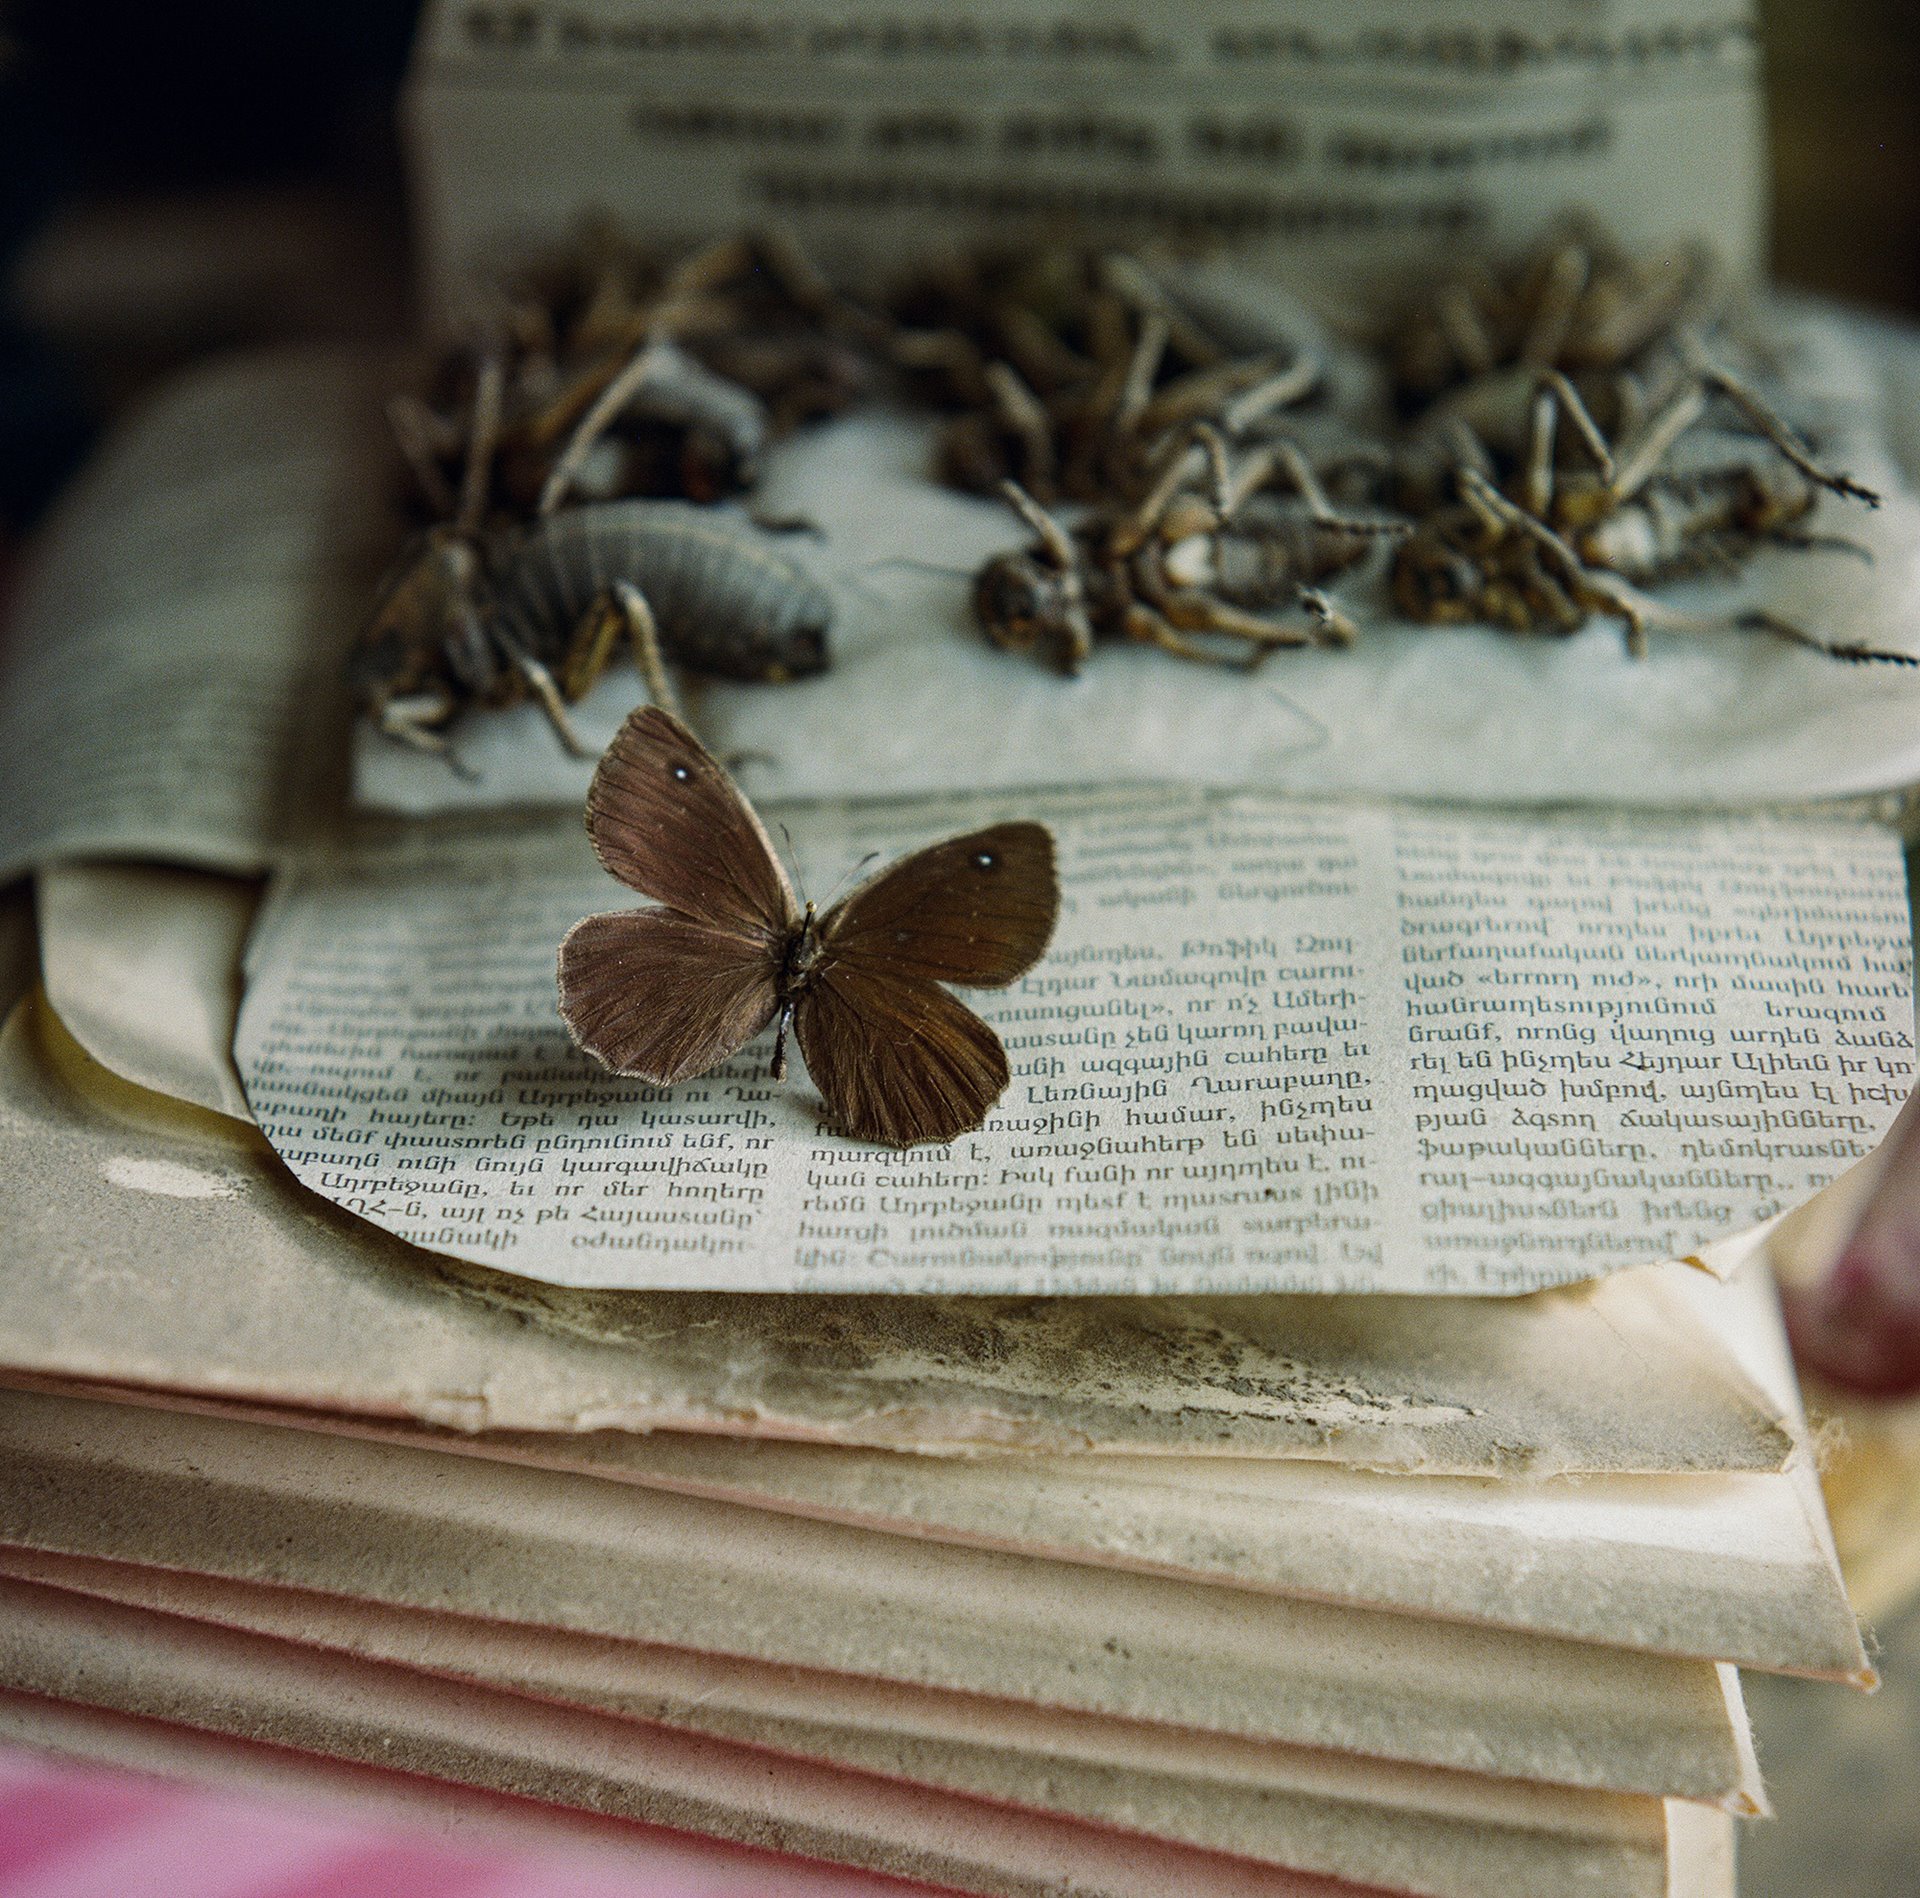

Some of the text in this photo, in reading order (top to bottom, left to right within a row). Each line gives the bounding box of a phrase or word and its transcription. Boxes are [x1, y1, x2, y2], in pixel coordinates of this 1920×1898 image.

[1404, 970, 1464, 994] ված
[1674, 972, 1717, 994] որի
[1731, 974, 1825, 998] մասին
[1837, 978, 1910, 999] հարե
[1188, 999, 1215, 1014] որ
[1273, 988, 1367, 1010] Ամերի-
[1406, 996, 1887, 1025] հանրապետությունում երազում
[1003, 1015, 1368, 1051] աստանը չեն կարող բավա-
[1408, 1022, 1501, 1043] նրանք,
[1517, 1022, 1596, 1045] որոնց
[1730, 1026, 1820, 1048] արդեն
[1835, 1028, 1914, 1050] ձանձ
[1081, 1049, 1208, 1075] ազգային
[1225, 1044, 1328, 1065] շահերը
[1411, 1053, 1450, 1074] րել
[1457, 1050, 1492, 1069] են
[1502, 1050, 1611, 1073] ինչպես
[1620, 1050, 1722, 1074] Հեյդար
[1838, 1053, 1867, 1077] իր
[686, 1090, 709, 1103] ու
[1027, 1070, 1372, 1105] Լեռնային Ղարաբաղը,
[1413, 1078, 1909, 1106] պացված խմբով, այնպես էլ իշխ
[500, 1112, 554, 1130] Եթե
[577, 1115, 619, 1130] դա
[642, 1110, 776, 1130] կատարվի,
[1125, 1106, 1236, 1126] համար,
[1260, 1095, 1373, 1121] ինչպես
[1416, 1107, 1876, 1134] թյան ձգտող ճակատայինները,
[313, 1126, 378, 1146] մենք
[384, 1131, 526, 1151] փաստորեն
[537, 1134, 672, 1154] ընդունում
[683, 1133, 735, 1152] ենք,
[745, 1137, 775, 1150] որ
[1011, 1134, 1204, 1160] առաջնահերթ
[1223, 1129, 1257, 1148] են
[1276, 1123, 1376, 1146] սեփա-
[1681, 1137, 1876, 1162] դեմոկրատնե
[396, 1156, 457, 1174] ունի
[475, 1156, 543, 1177] նույն
[561, 1156, 768, 1179] կարգավիճակը
[806, 1170, 865, 1190] կան
[875, 1170, 988, 1191] շահերը:
[1000, 1166, 1054, 1187] Իսկ
[1063, 1164, 1136, 1186] քանի
[1146, 1166, 1174, 1181] որ
[1183, 1156, 1298, 1182] այդպես
[320, 1172, 488, 1199] Ադրբեջանը,
[555, 1184, 584, 1197] որ
[603, 1181, 649, 1198] մեր
[668, 1182, 764, 1203] հողերը
[441, 1205, 484, 1224] այլ
[496, 1208, 525, 1224] ոչ
[536, 1205, 569, 1225] թե
